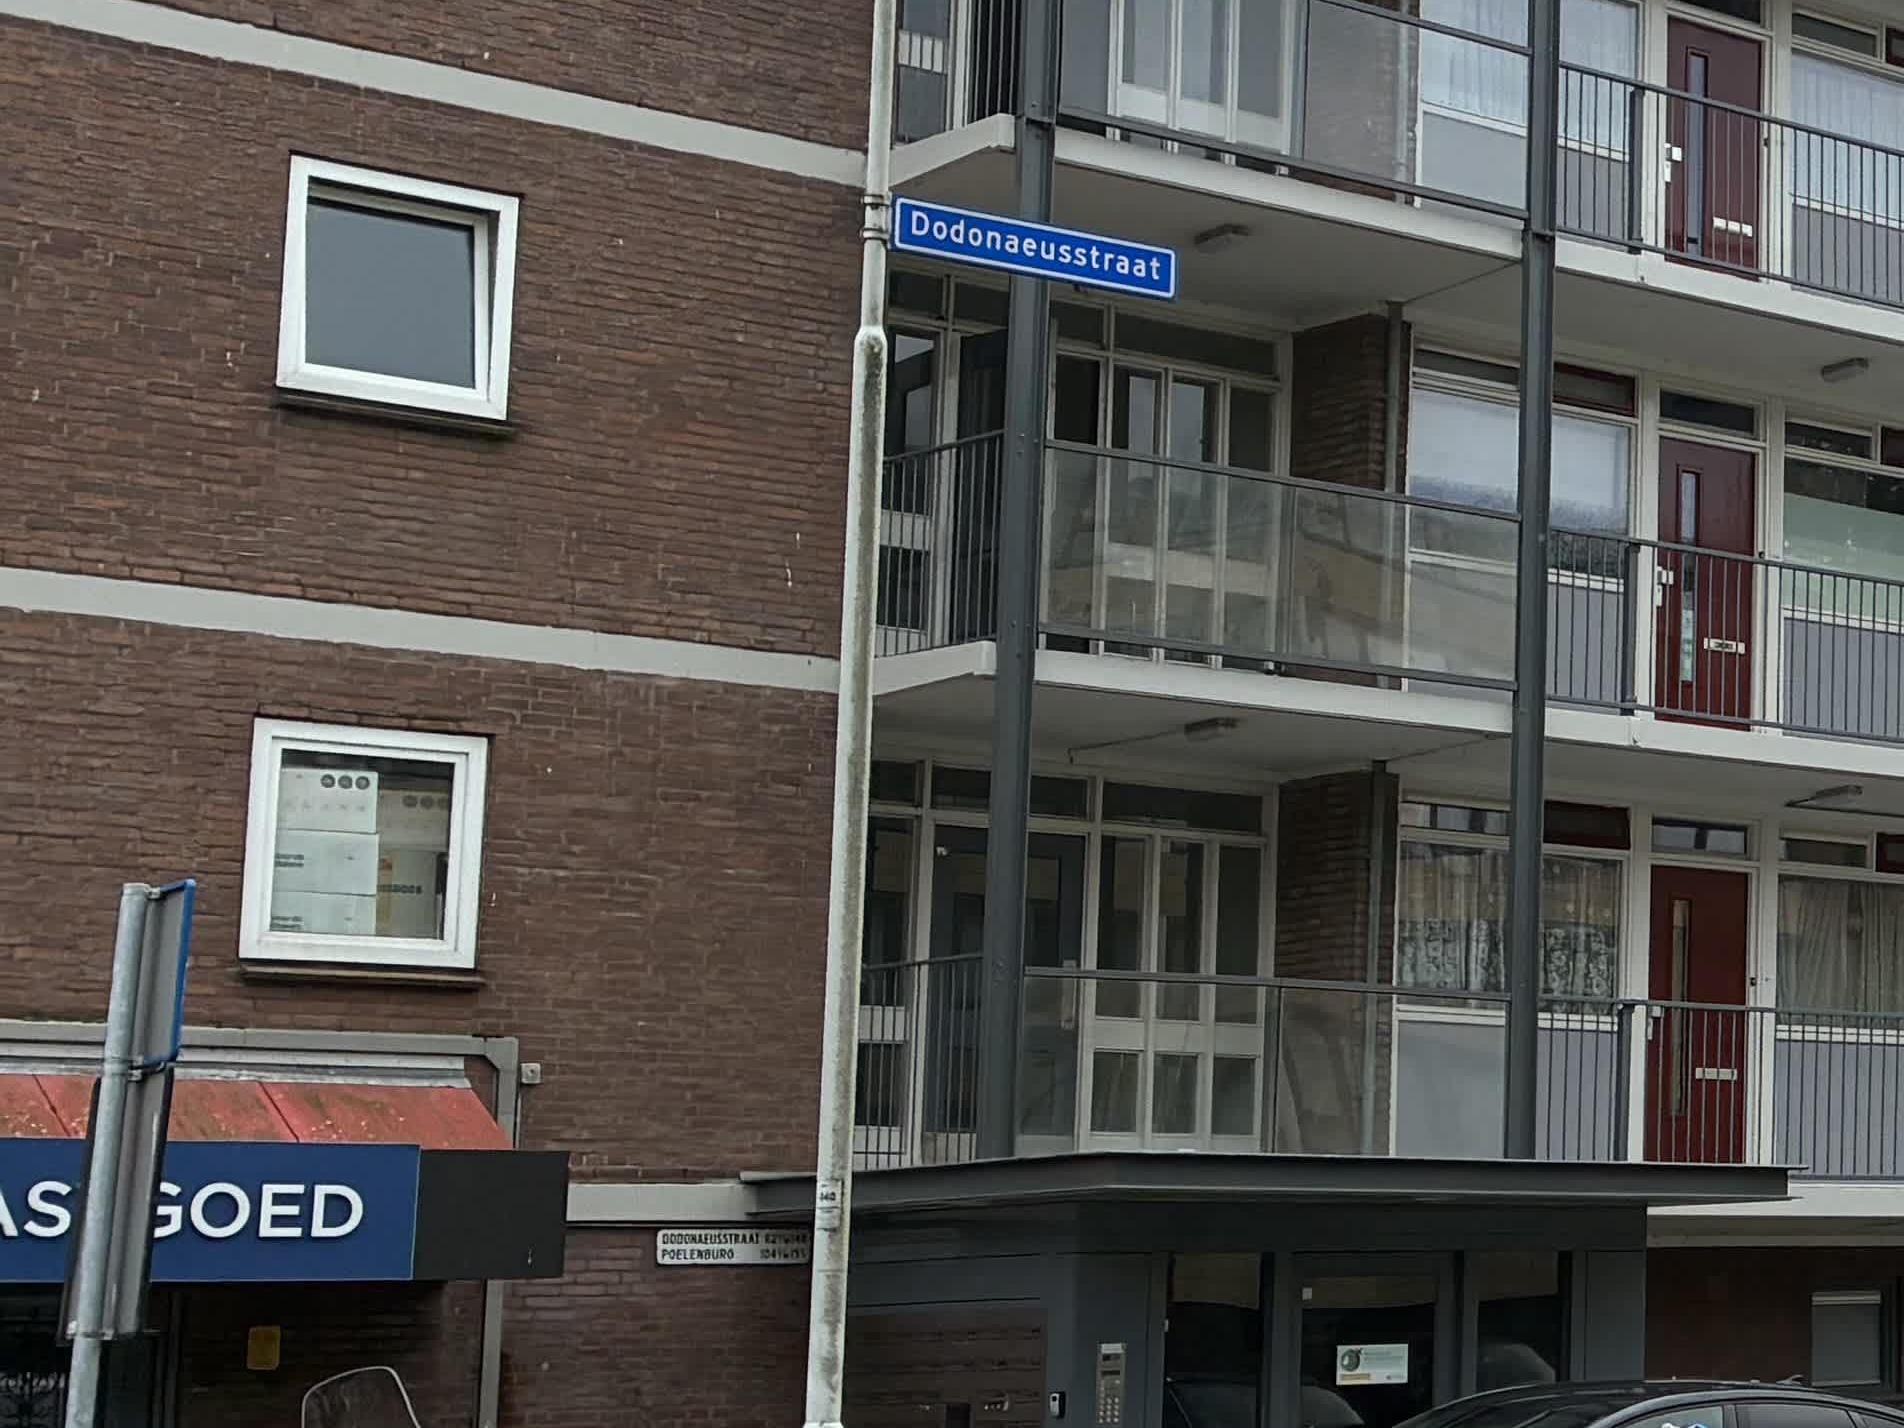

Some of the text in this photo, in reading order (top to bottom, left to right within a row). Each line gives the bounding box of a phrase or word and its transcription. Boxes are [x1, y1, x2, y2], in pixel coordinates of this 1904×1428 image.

[911, 210, 1161, 281] Dodonaeusstraat
[0, 1180, 364, 1239] SGOED
[661, 1248, 735, 1260] POELENBURG
[662, 1233, 759, 1245] DODONAEUSSTRAAT
